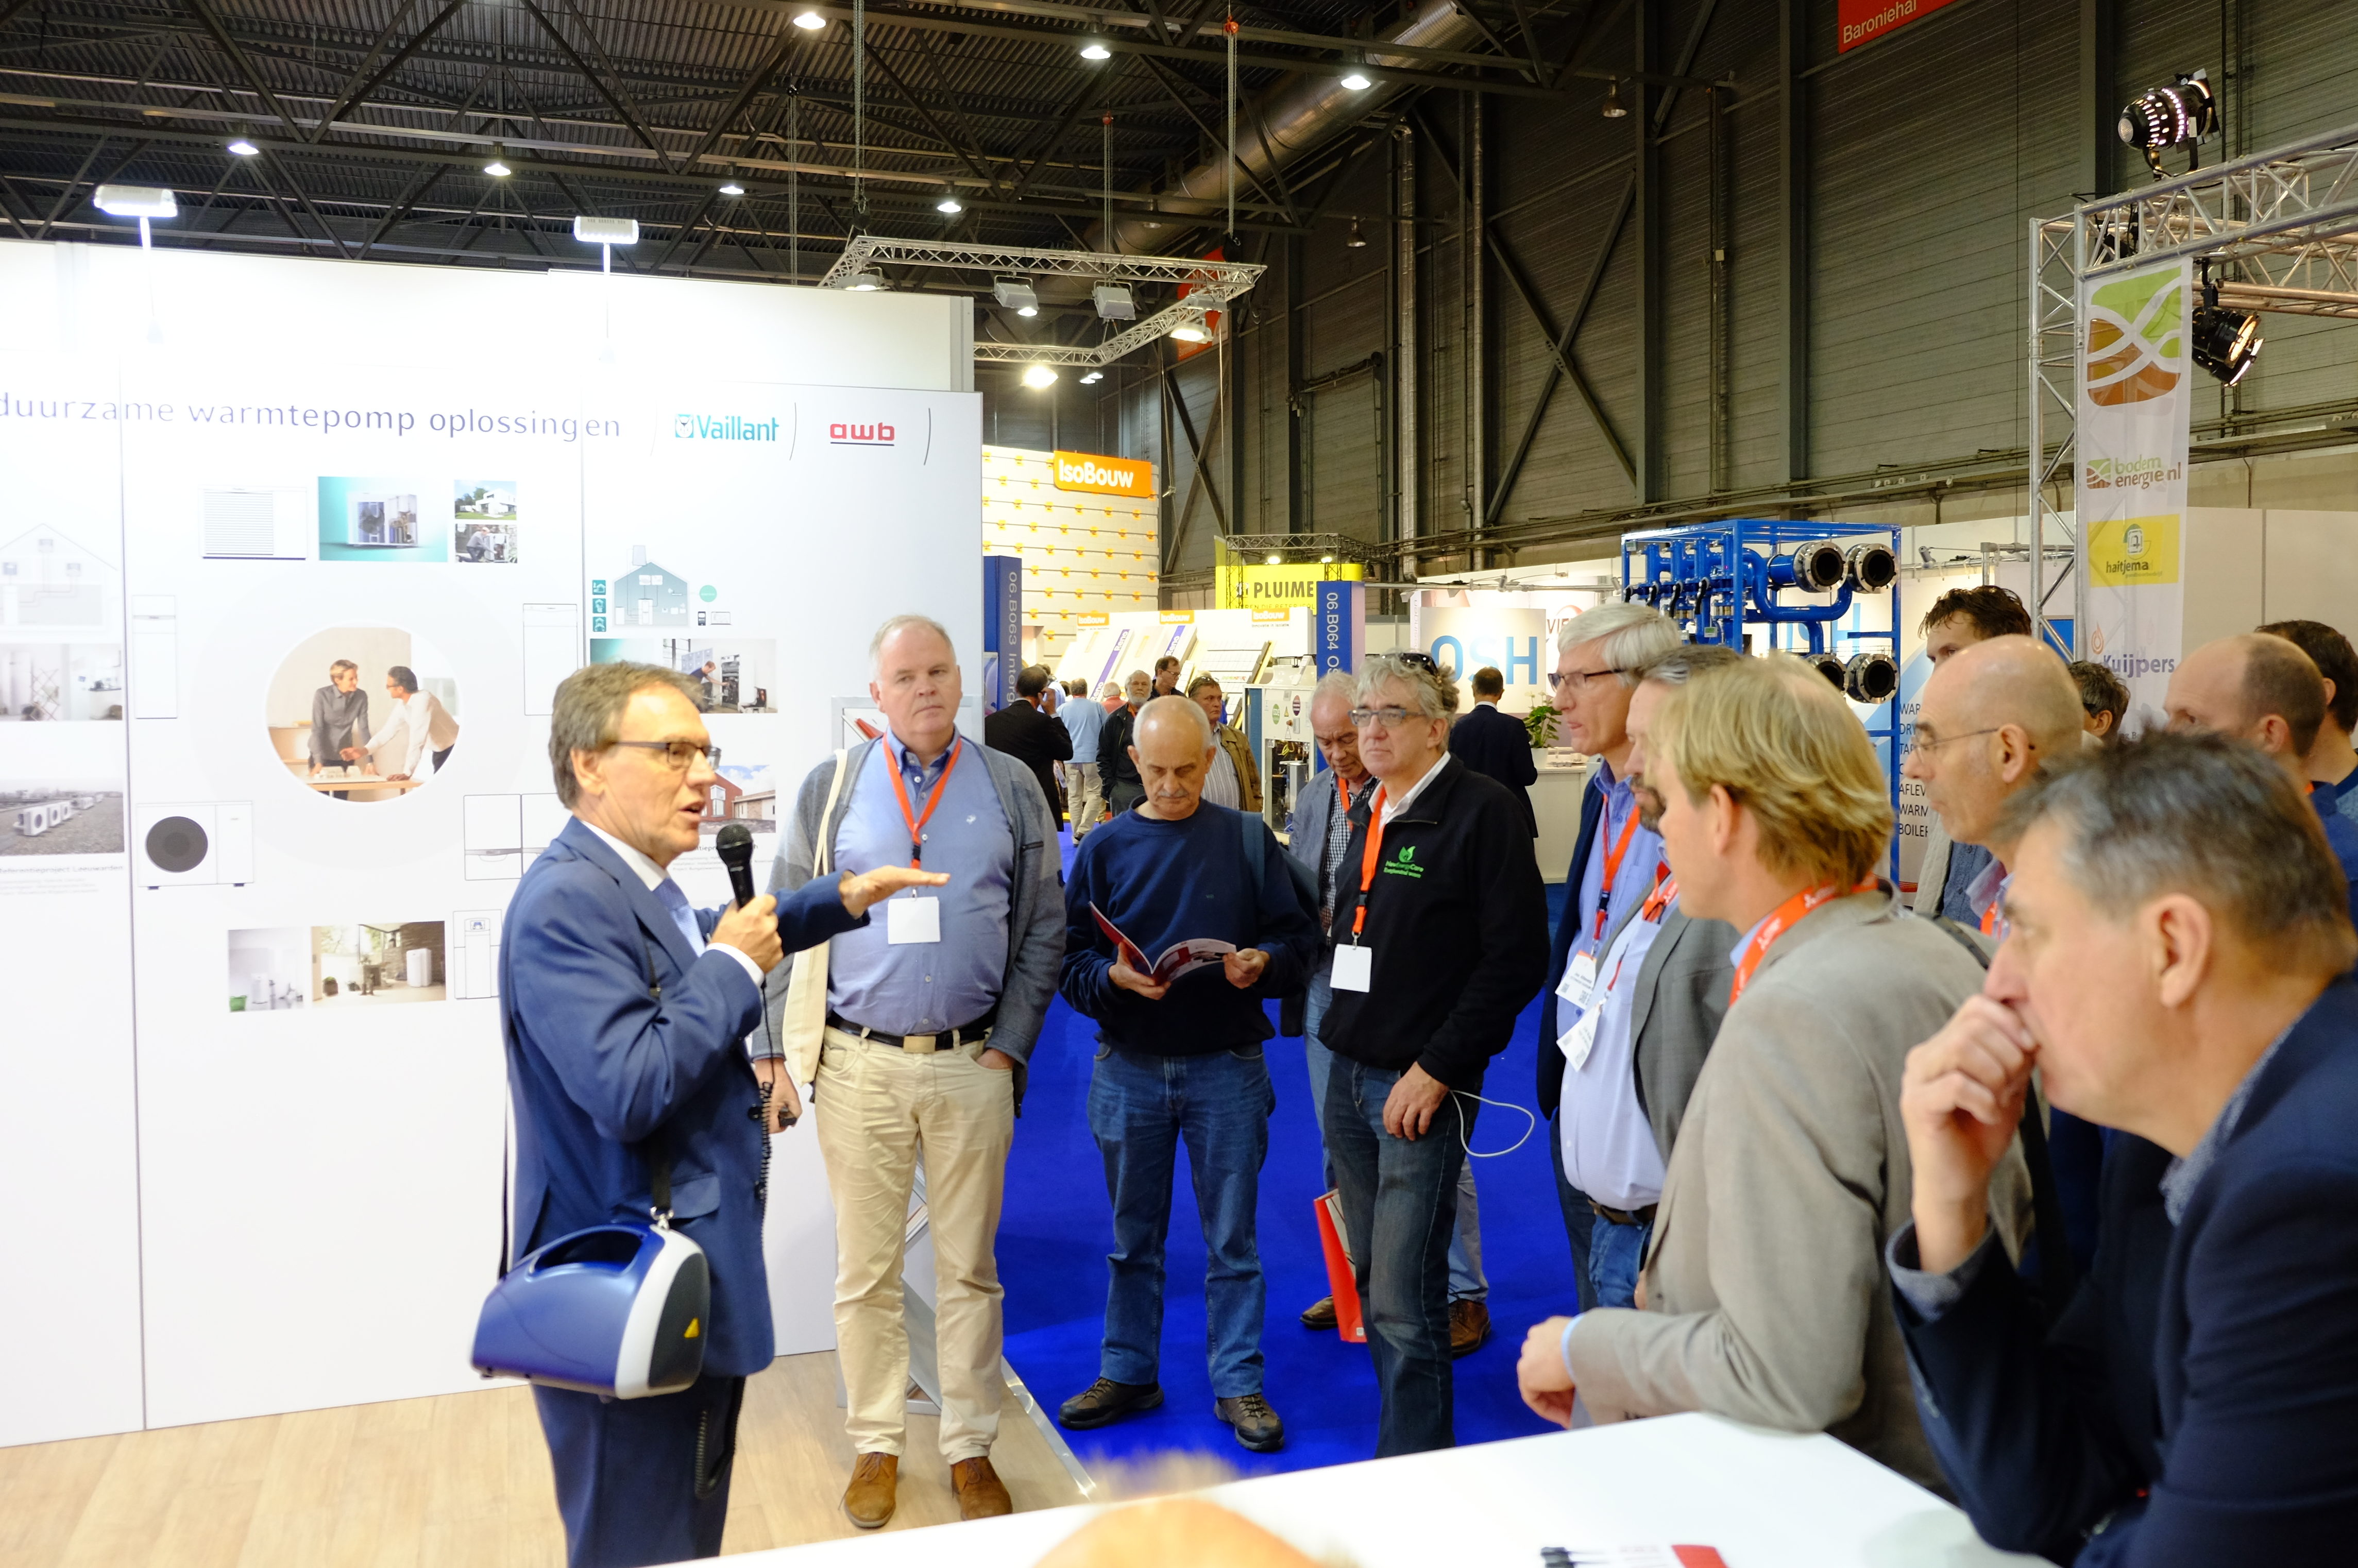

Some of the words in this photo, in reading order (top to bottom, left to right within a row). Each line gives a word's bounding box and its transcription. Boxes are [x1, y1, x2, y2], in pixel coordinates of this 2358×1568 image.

[1843, 0, 1916, 44] Baroniehal
[189, 405, 415, 437] warmtepomp
[430, 408, 619, 442] oplossingen
[697, 415, 779, 441] Vaillant
[829, 421, 895, 441] awb
[1059, 458, 1134, 488] IsoBouw
[2114, 454, 2162, 475] bodem
[2115, 462, 2181, 490] energienl
[2106, 560, 2149, 575] haitjema
[1009, 571, 1017, 645] 06.B063
[1327, 592, 1339, 651] 06.B064
[1114, 630, 1129, 651] Reno
[1165, 635, 1180, 656] Reno
[1431, 635, 1538, 685] OSH
[2103, 654, 2175, 678] Kuijpers
[1007, 653, 1017, 707] Interg
